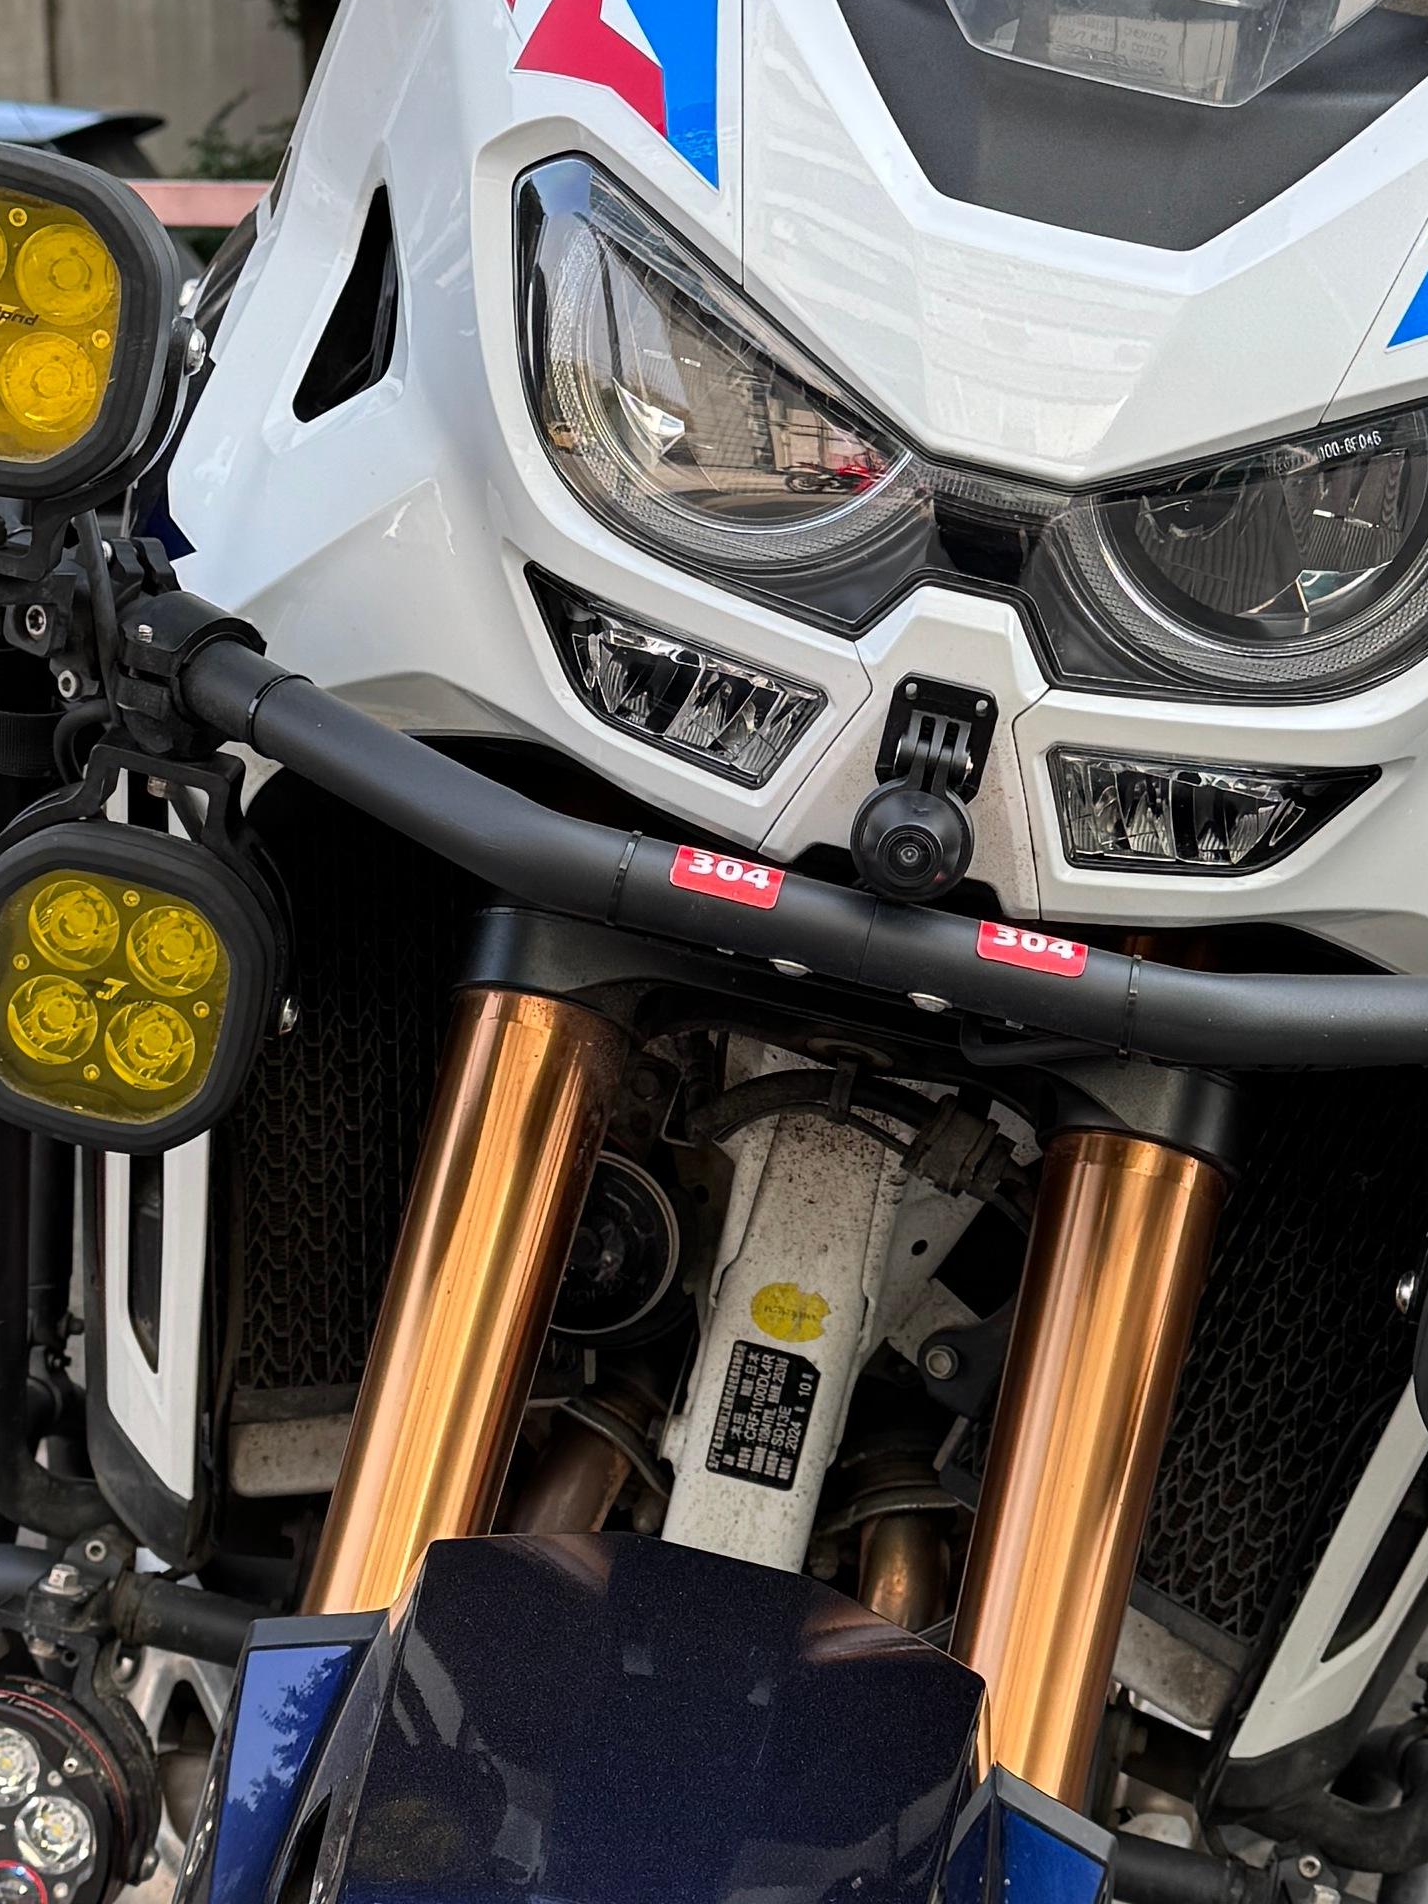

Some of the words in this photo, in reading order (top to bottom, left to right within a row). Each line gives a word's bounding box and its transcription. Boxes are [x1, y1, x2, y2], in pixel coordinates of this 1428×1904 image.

[688, 851, 770, 890] 304
[992, 924, 1075, 960] 304
[731, 1411, 747, 1441] 本田
[744, 1352, 761, 1376] 日本
[744, 1354, 775, 1441] CRF1100DL4R
[771, 1405, 792, 1448] SD13E
[784, 1421, 803, 1452] 2024
